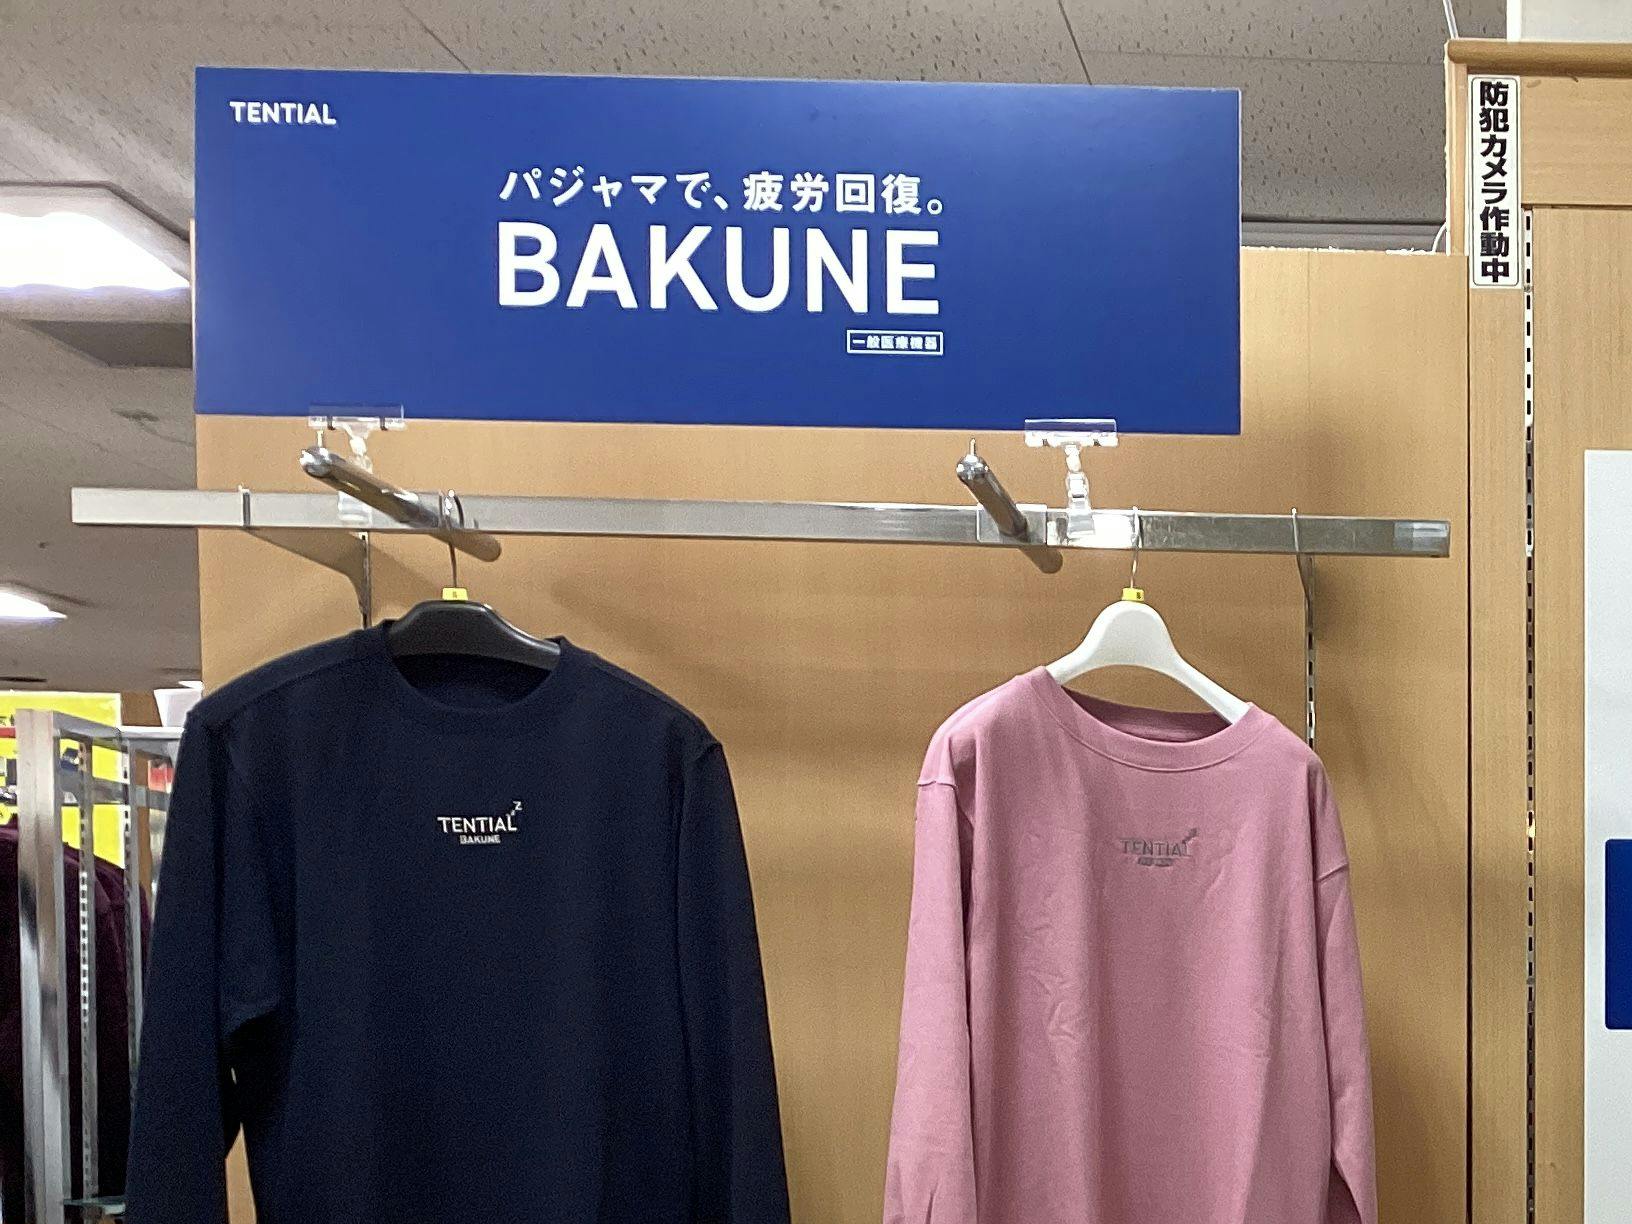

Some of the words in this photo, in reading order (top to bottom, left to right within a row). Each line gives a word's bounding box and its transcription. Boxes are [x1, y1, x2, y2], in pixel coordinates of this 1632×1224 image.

[229, 101, 337, 126] TENTIAL
[499, 166, 945, 217] パジャマで、疲労回復。
[1479, 80, 1510, 283] 防犯カメラ作動中
[498, 221, 940, 315] BAKUNE
[853, 333, 938, 352] 一般医療機器
[437, 813, 518, 833] TENTIAL
